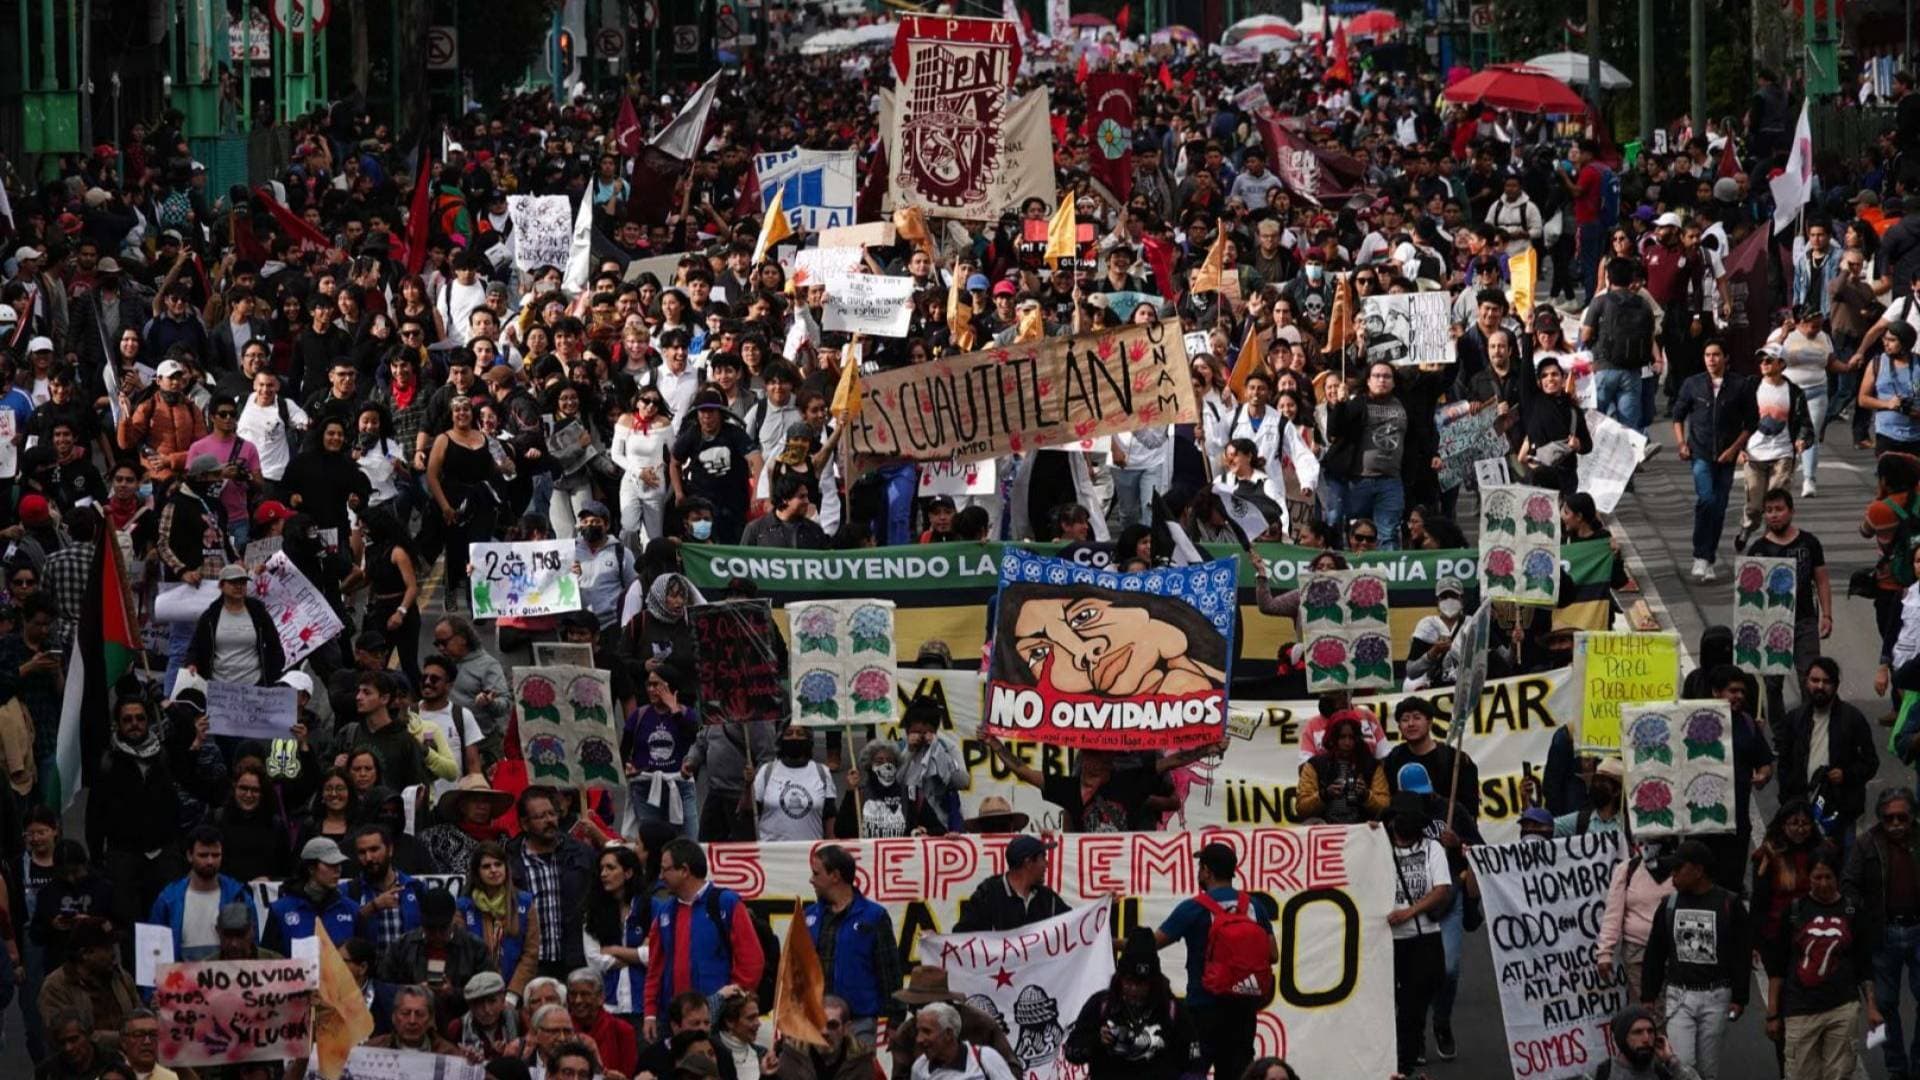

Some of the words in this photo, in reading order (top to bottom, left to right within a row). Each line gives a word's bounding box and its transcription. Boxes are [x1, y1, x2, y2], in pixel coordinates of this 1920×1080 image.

[755, 150, 798, 174] IPN
[899, 339, 1134, 452] CUAUTITLÁN
[710, 556, 950, 581] CONSTRUYENDO
[959, 554, 997, 576] LA
[990, 686, 1043, 730] NO
[1052, 696, 1222, 731] OLVIDAMOS
[939, 906, 1107, 969] ATLAPULCO
[1493, 911, 1559, 951] CODO
[198, 968, 230, 990] NO
[1514, 1027, 1588, 1077] SOMOS
